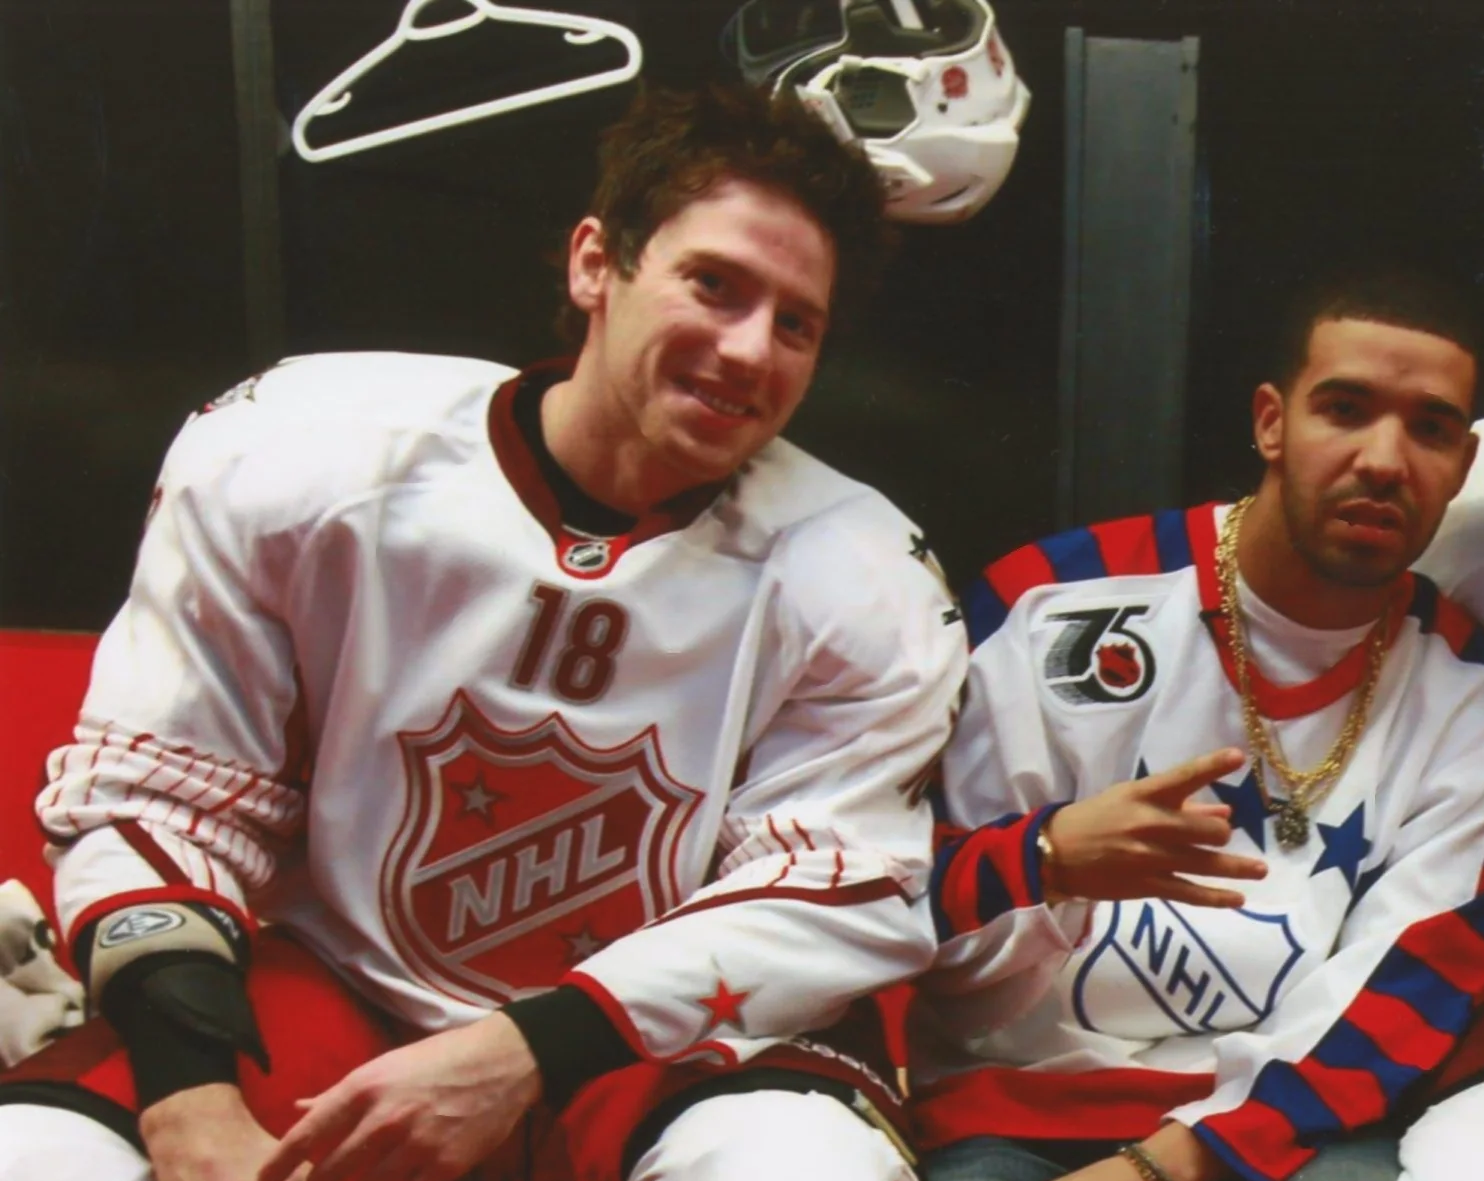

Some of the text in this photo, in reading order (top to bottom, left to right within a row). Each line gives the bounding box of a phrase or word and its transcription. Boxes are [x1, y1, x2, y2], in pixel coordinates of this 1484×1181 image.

[508, 579, 631, 705] 18
[1043, 604, 1156, 706] 75
[446, 813, 627, 943] NHL
[1130, 902, 1226, 1031] NHL
